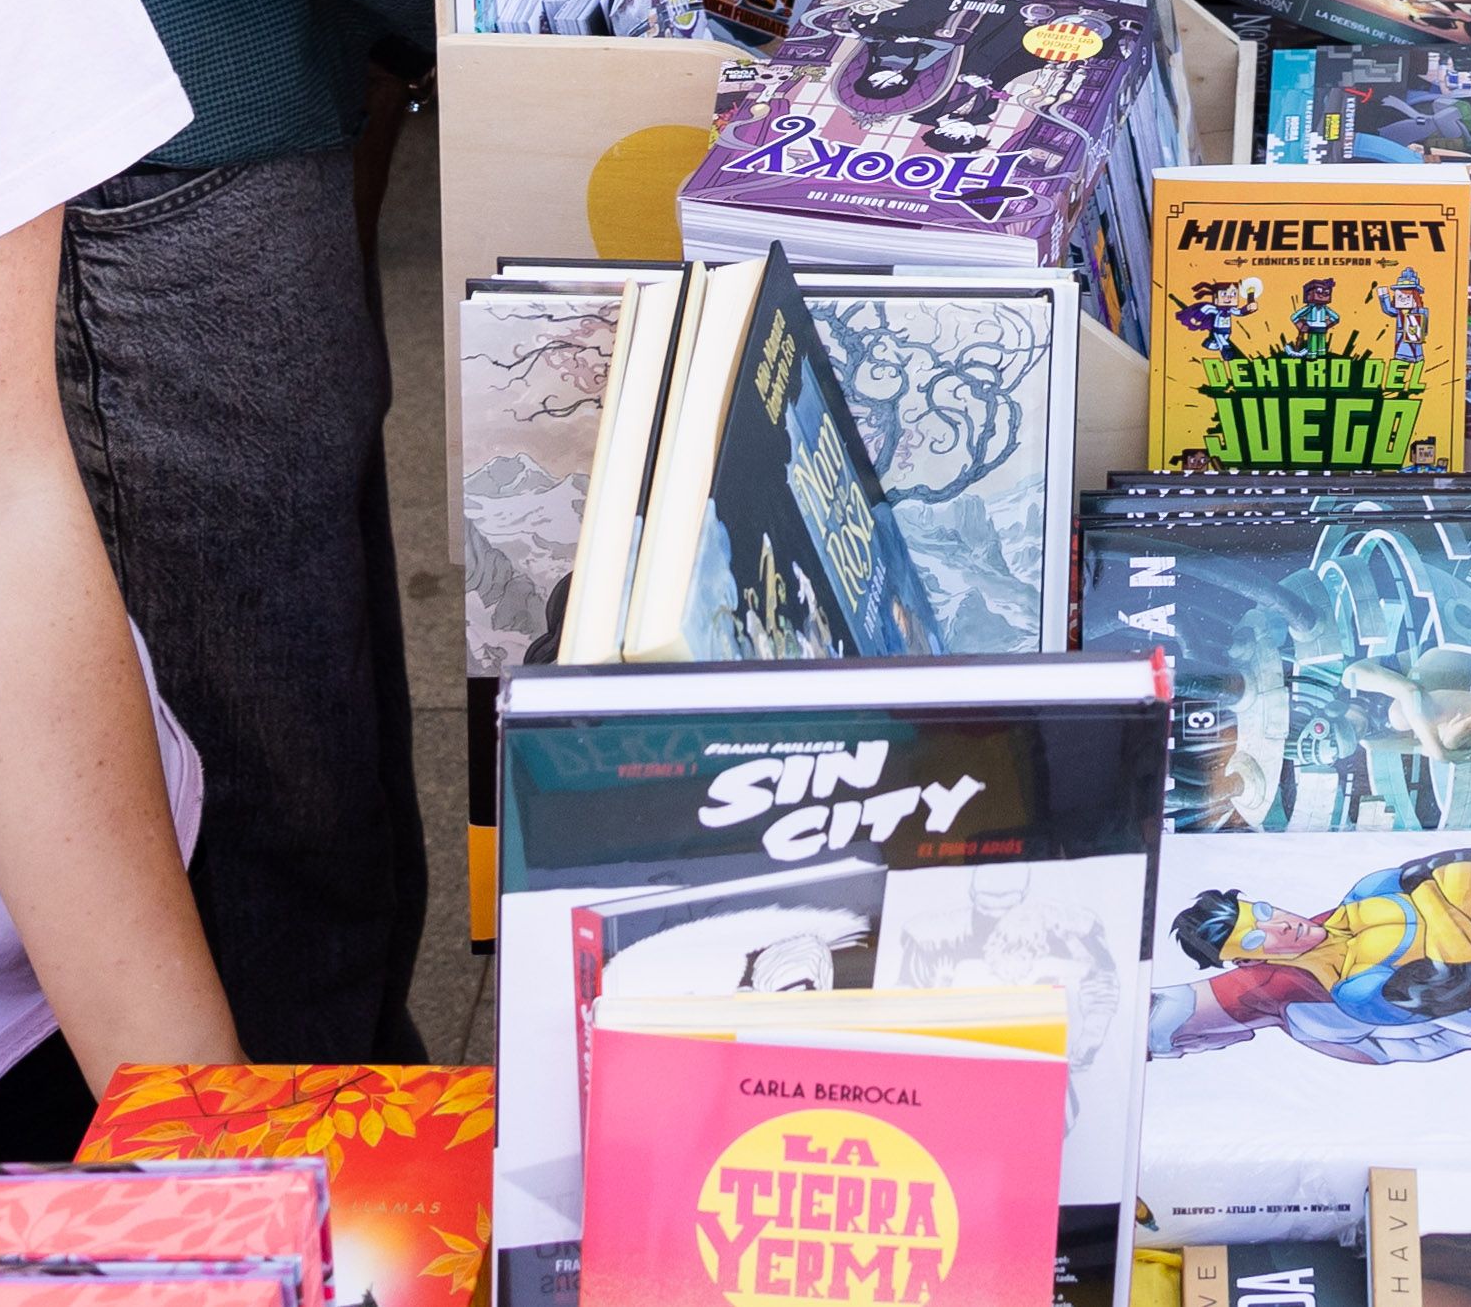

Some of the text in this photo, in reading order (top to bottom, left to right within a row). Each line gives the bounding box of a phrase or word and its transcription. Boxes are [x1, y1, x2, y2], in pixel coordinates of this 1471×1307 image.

[1315, 8, 1388, 39] LA DEESSA DE
[1177, 219, 1446, 252] MINECRAFT
[1251, 255, 1372, 267] CRÓNICAS DE LA ESPADA
[1202, 358, 1427, 390] DENTRO DEL
[1203, 396, 1423, 467] JUEGO
[1187, 711, 1216, 730] 3
[698, 739, 890, 828] SIN
[761, 774, 986, 862] CITY
[739, 1078, 923, 1108] CARLA BERROCAL
[782, 1133, 880, 1168] LA
[719, 1167, 941, 1239] TIERRA
[696, 1210, 945, 1305] YERMA
